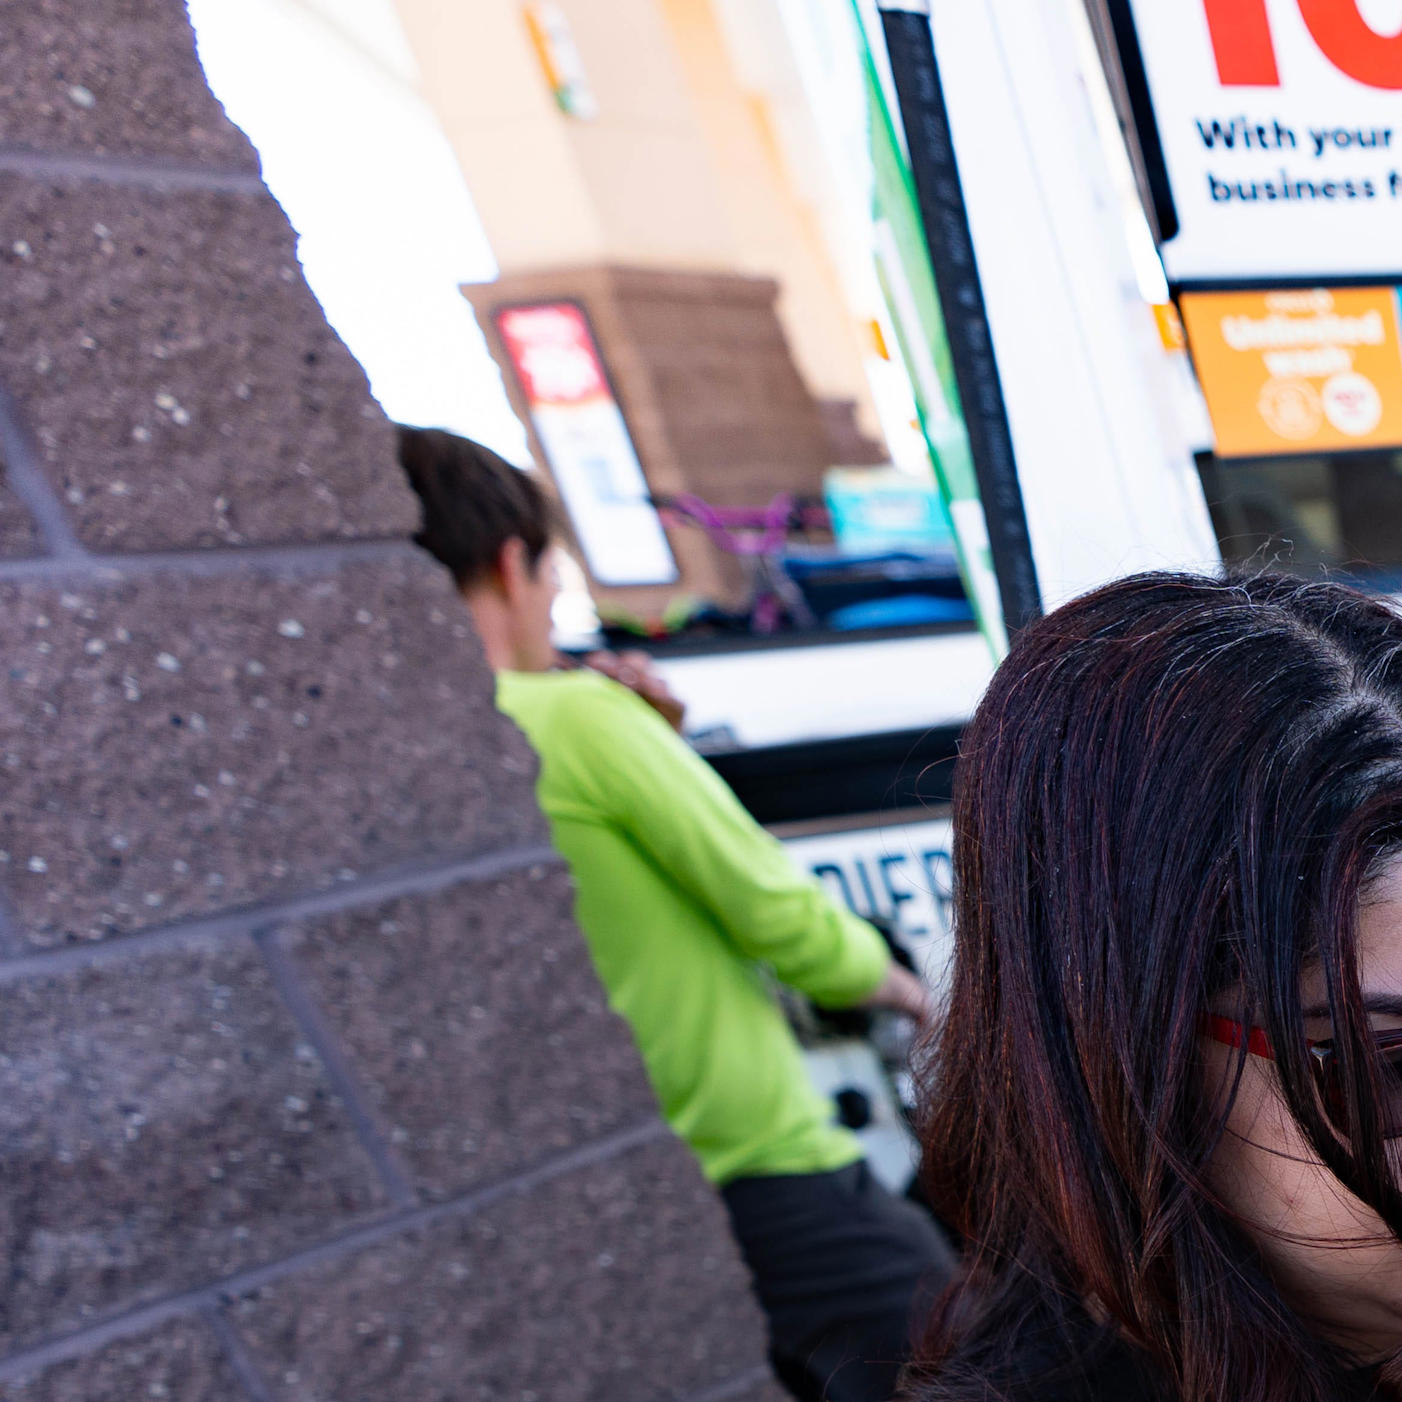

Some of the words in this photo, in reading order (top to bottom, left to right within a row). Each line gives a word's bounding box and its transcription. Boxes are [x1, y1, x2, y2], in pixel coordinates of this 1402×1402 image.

[1195, 115, 1297, 149] With
[1309, 127, 1393, 157] your
[1207, 169, 1376, 202] business
